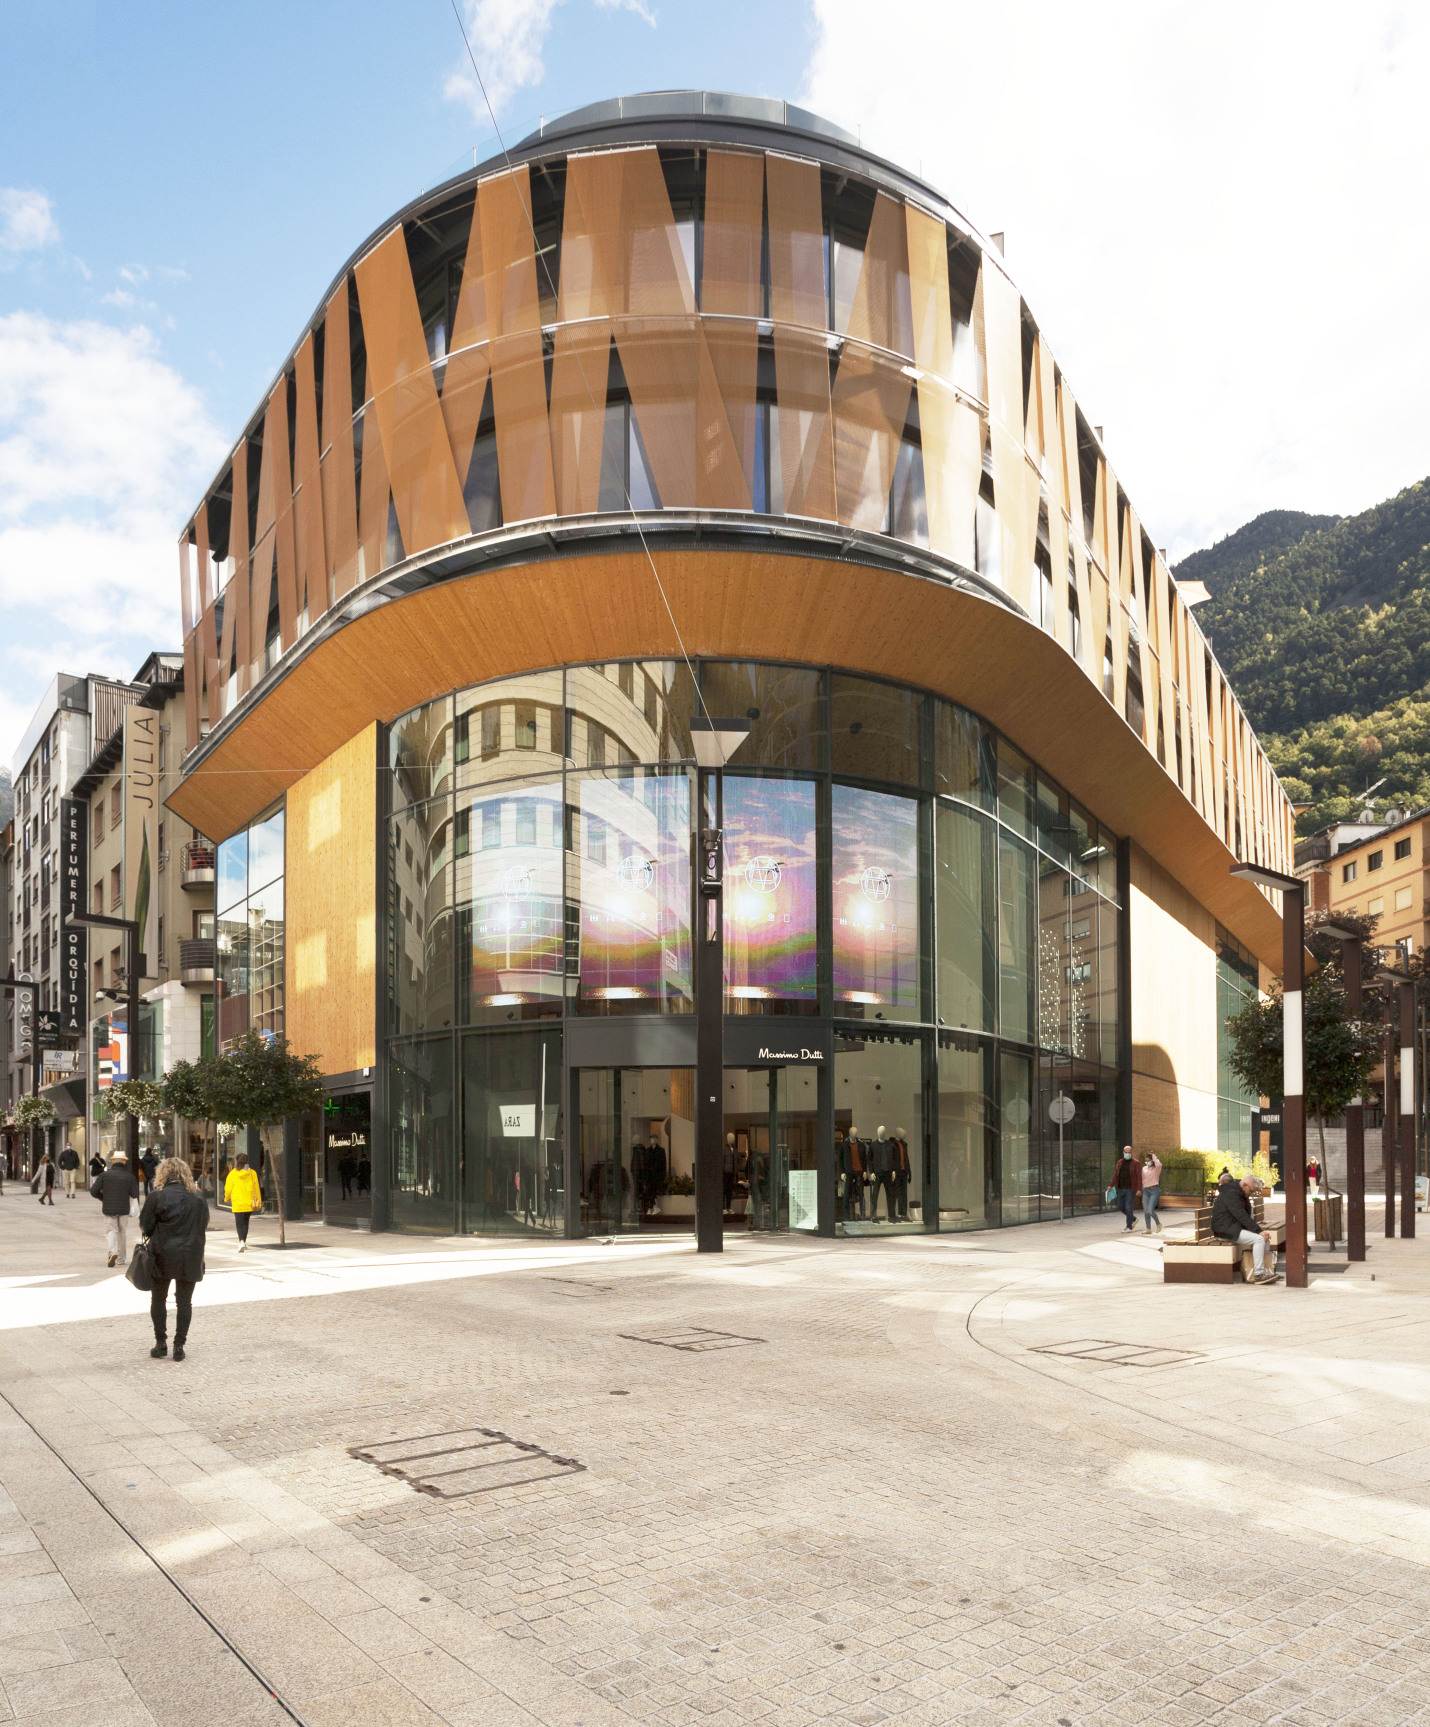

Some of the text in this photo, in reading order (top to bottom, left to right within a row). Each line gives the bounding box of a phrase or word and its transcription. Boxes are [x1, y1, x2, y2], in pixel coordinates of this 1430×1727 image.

[68, 807, 79, 913] PERFUMERI
[758, 1047, 824, 1060] Massimo Dutti
[328, 1132, 367, 1148] Massimo Dutti
